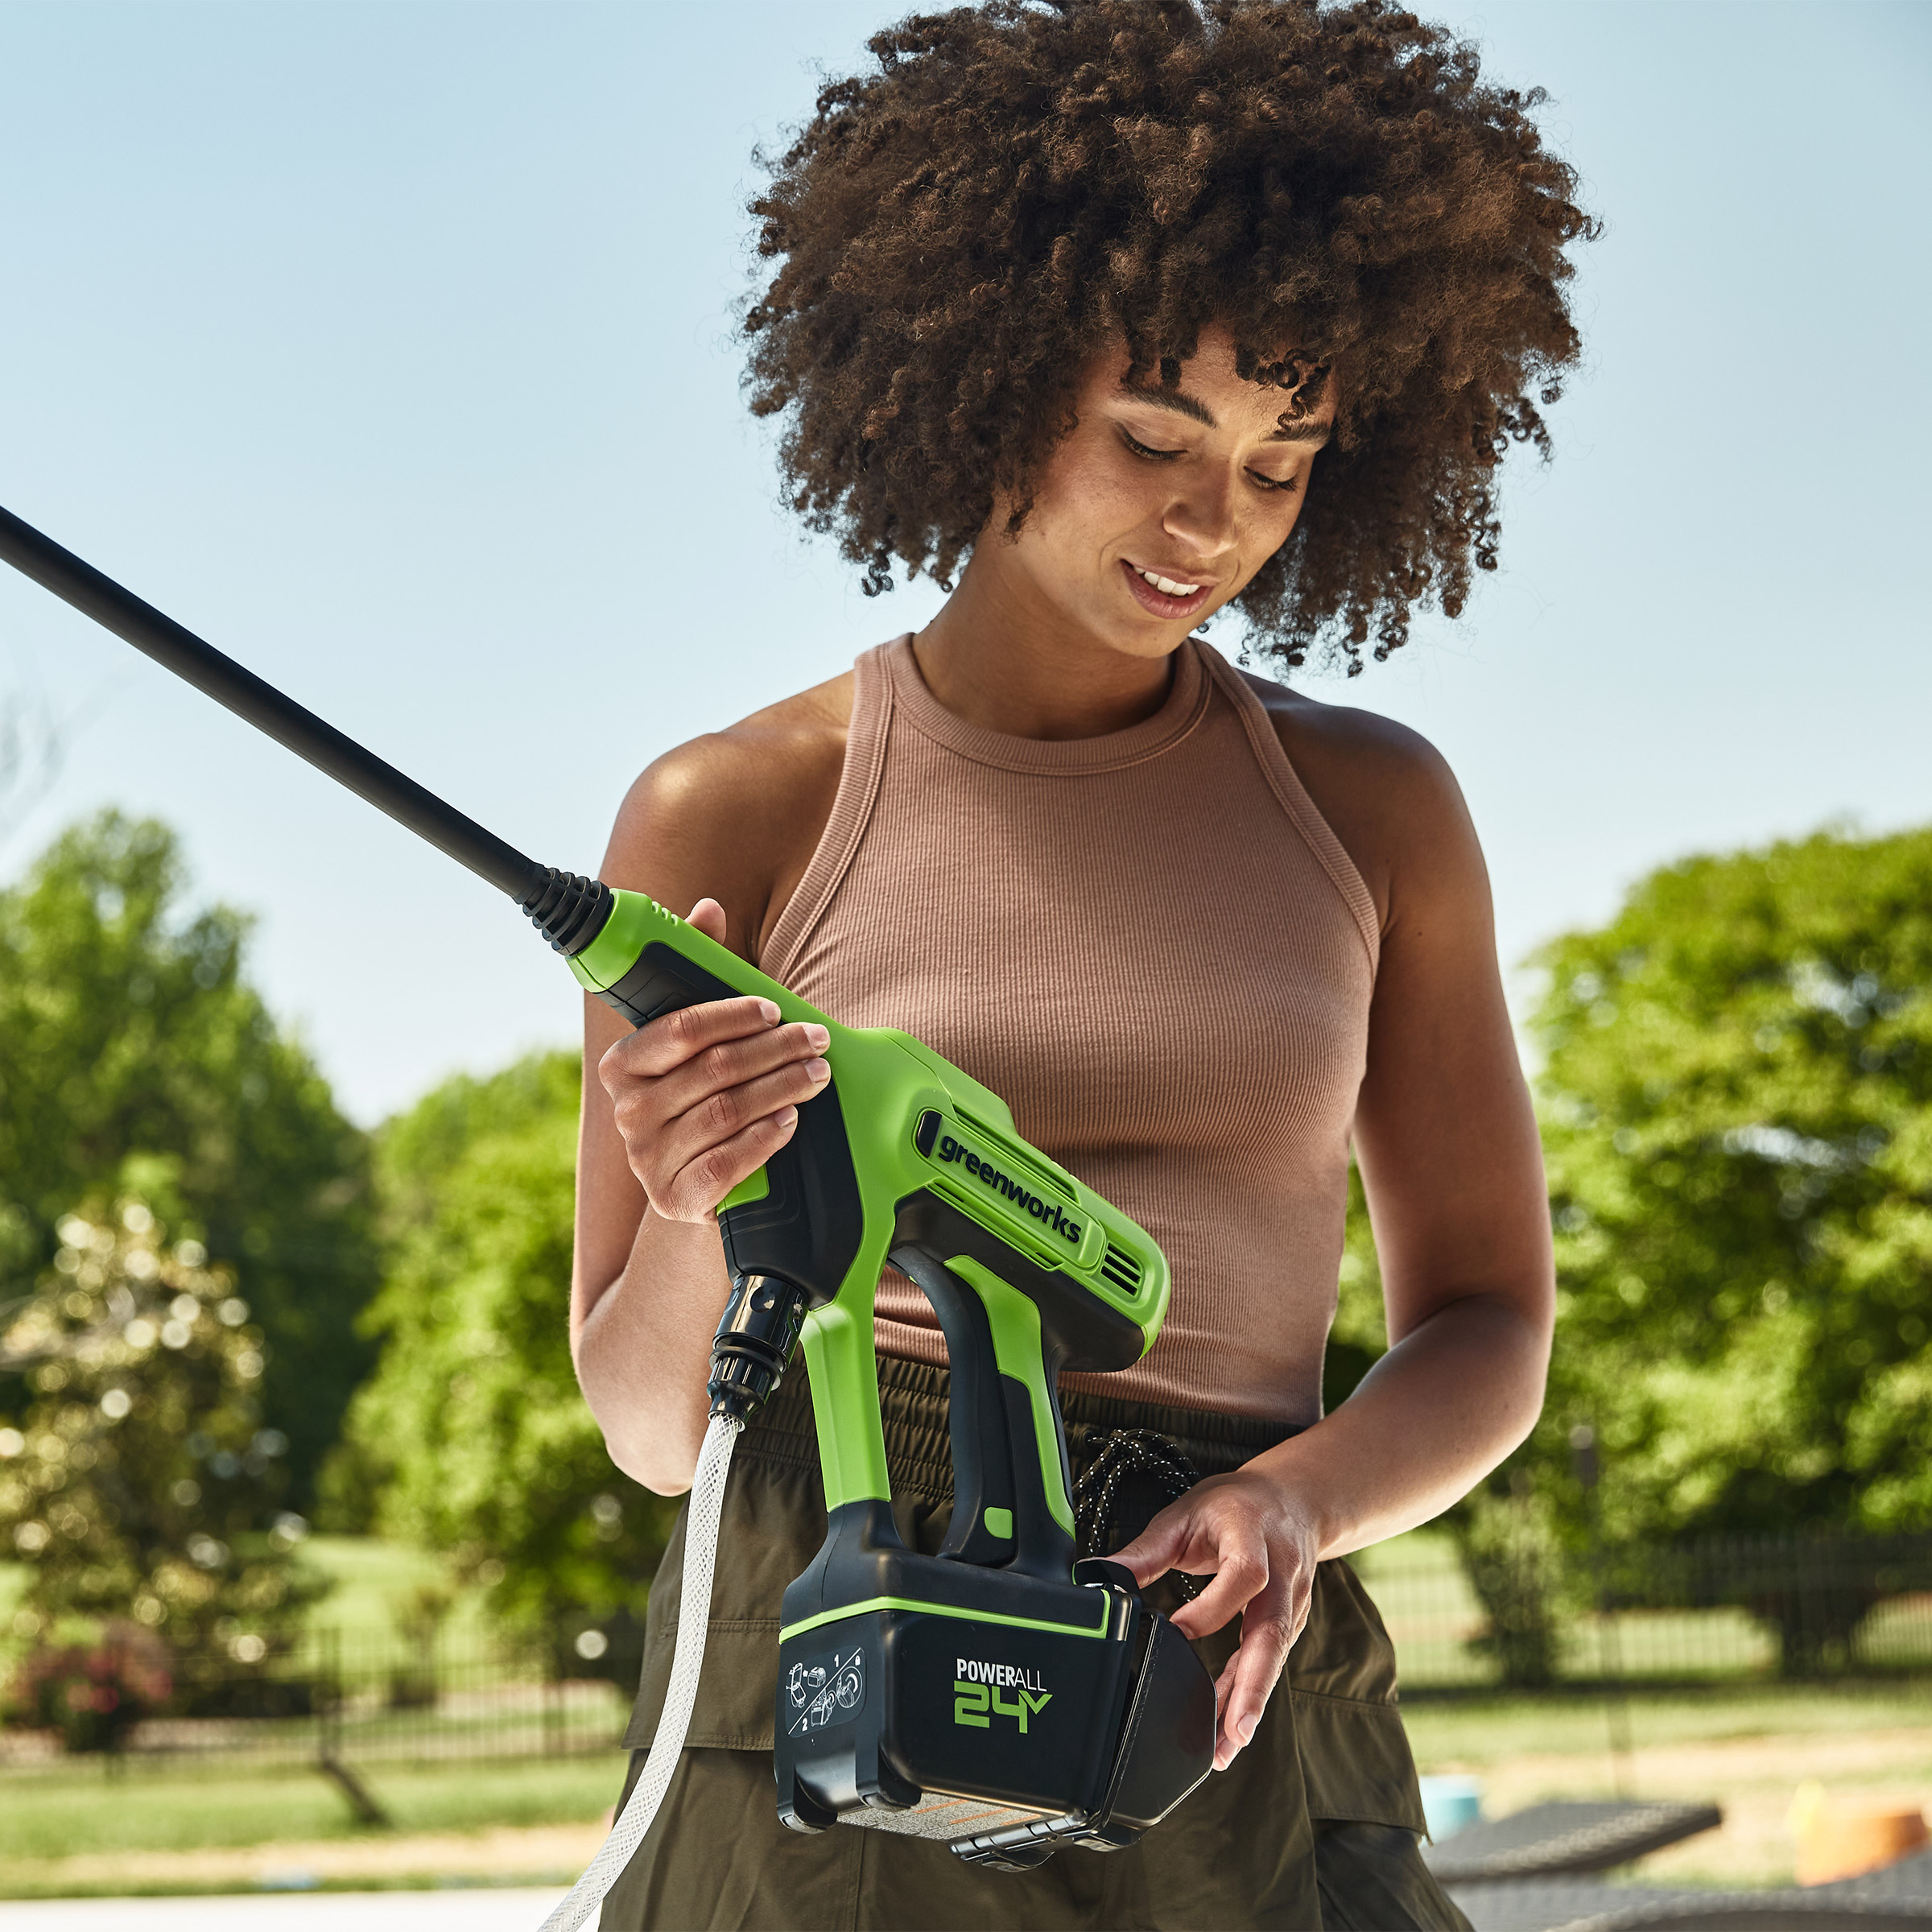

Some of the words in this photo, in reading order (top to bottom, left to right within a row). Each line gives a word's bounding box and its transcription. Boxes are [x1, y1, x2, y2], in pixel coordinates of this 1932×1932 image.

[939, 1135, 1081, 1243] greenworks
[834, 1654, 840, 1667] 1
[956, 1658, 1047, 1691] POWERALL
[802, 1718, 808, 1732] 2
